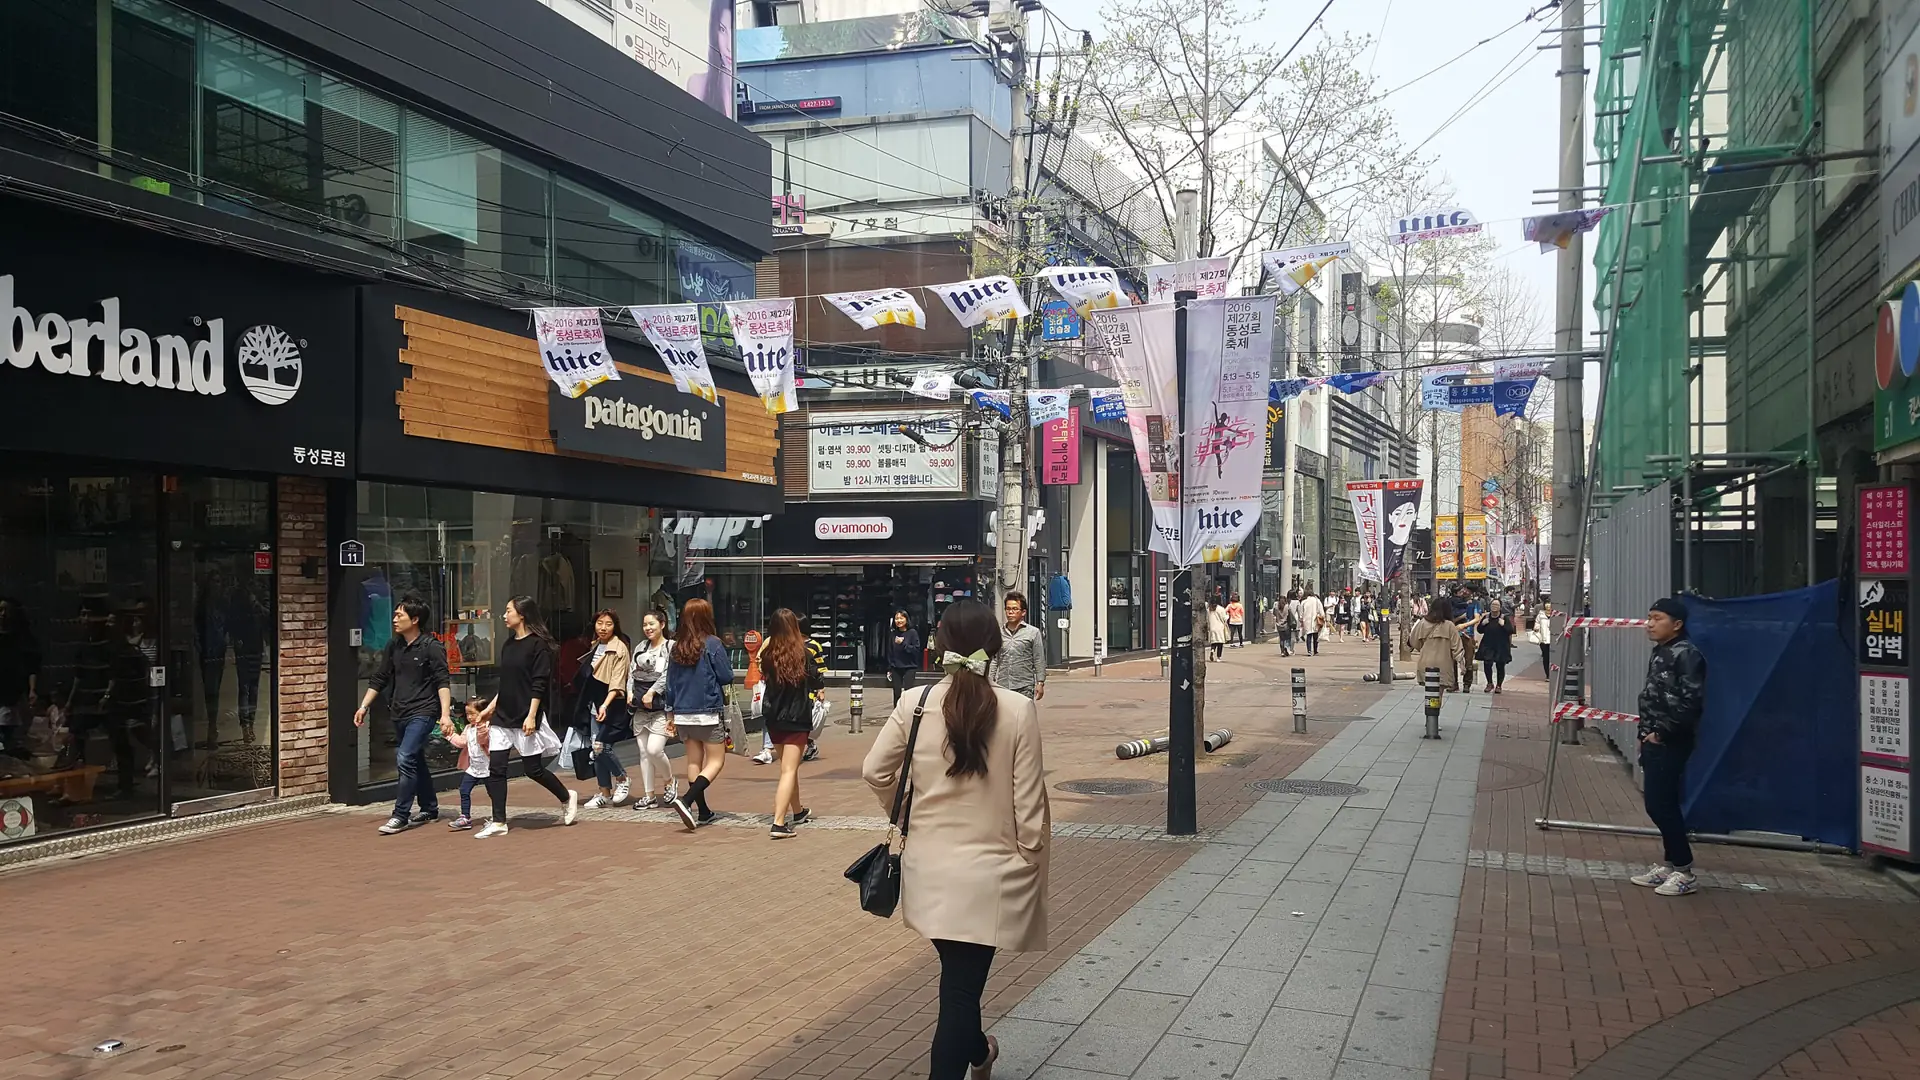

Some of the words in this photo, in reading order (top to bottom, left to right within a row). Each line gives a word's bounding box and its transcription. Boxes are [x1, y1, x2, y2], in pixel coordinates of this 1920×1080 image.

[635, 2, 671, 48] 리프팅
[634, 35, 681, 76] 물광주사
[1200, 269, 1227, 281] 제27회
[849, 290, 909, 312] hite
[950, 279, 1008, 314] hite
[1227, 303, 1251, 313] 2016
[653, 315, 672, 324] 2016
[747, 311, 767, 320] 2016
[1096, 314, 1117, 324] 2016
[1227, 311, 1261, 324] 제27회
[555, 318, 573, 328] 2016
[576, 318, 599, 327] 제27회
[749, 320, 792, 335] 동성로축제
[0, 274, 226, 396] berland
[556, 328, 603, 342] 동성로축제
[1226, 323, 1262, 337] 동성로
[1225, 337, 1249, 350] 축제
[545, 348, 604, 373] hite
[738, 342, 787, 373] hite
[1508, 387, 1528, 397] DGB
[584, 395, 703, 441] patagonia
[293, 446, 346, 467] 동성로점
[817, 460, 833, 469] 매직
[877, 458, 907, 468] 볼륨매직
[929, 458, 955, 468] 59,900
[843, 475, 851, 486] 밤
[854, 475, 872, 485] 12시
[874, 475, 891, 485] 까지
[893, 474, 933, 486] 영업합니다
[1866, 490, 1904, 499] 메이크업
[1198, 506, 1244, 531] hite
[1866, 520, 1904, 529] 스타일리스트
[831, 522, 888, 534] viamonoh
[347, 552, 357, 563] 11
[1866, 609, 1903, 634] 실내
[1866, 634, 1902, 660] 암벽
